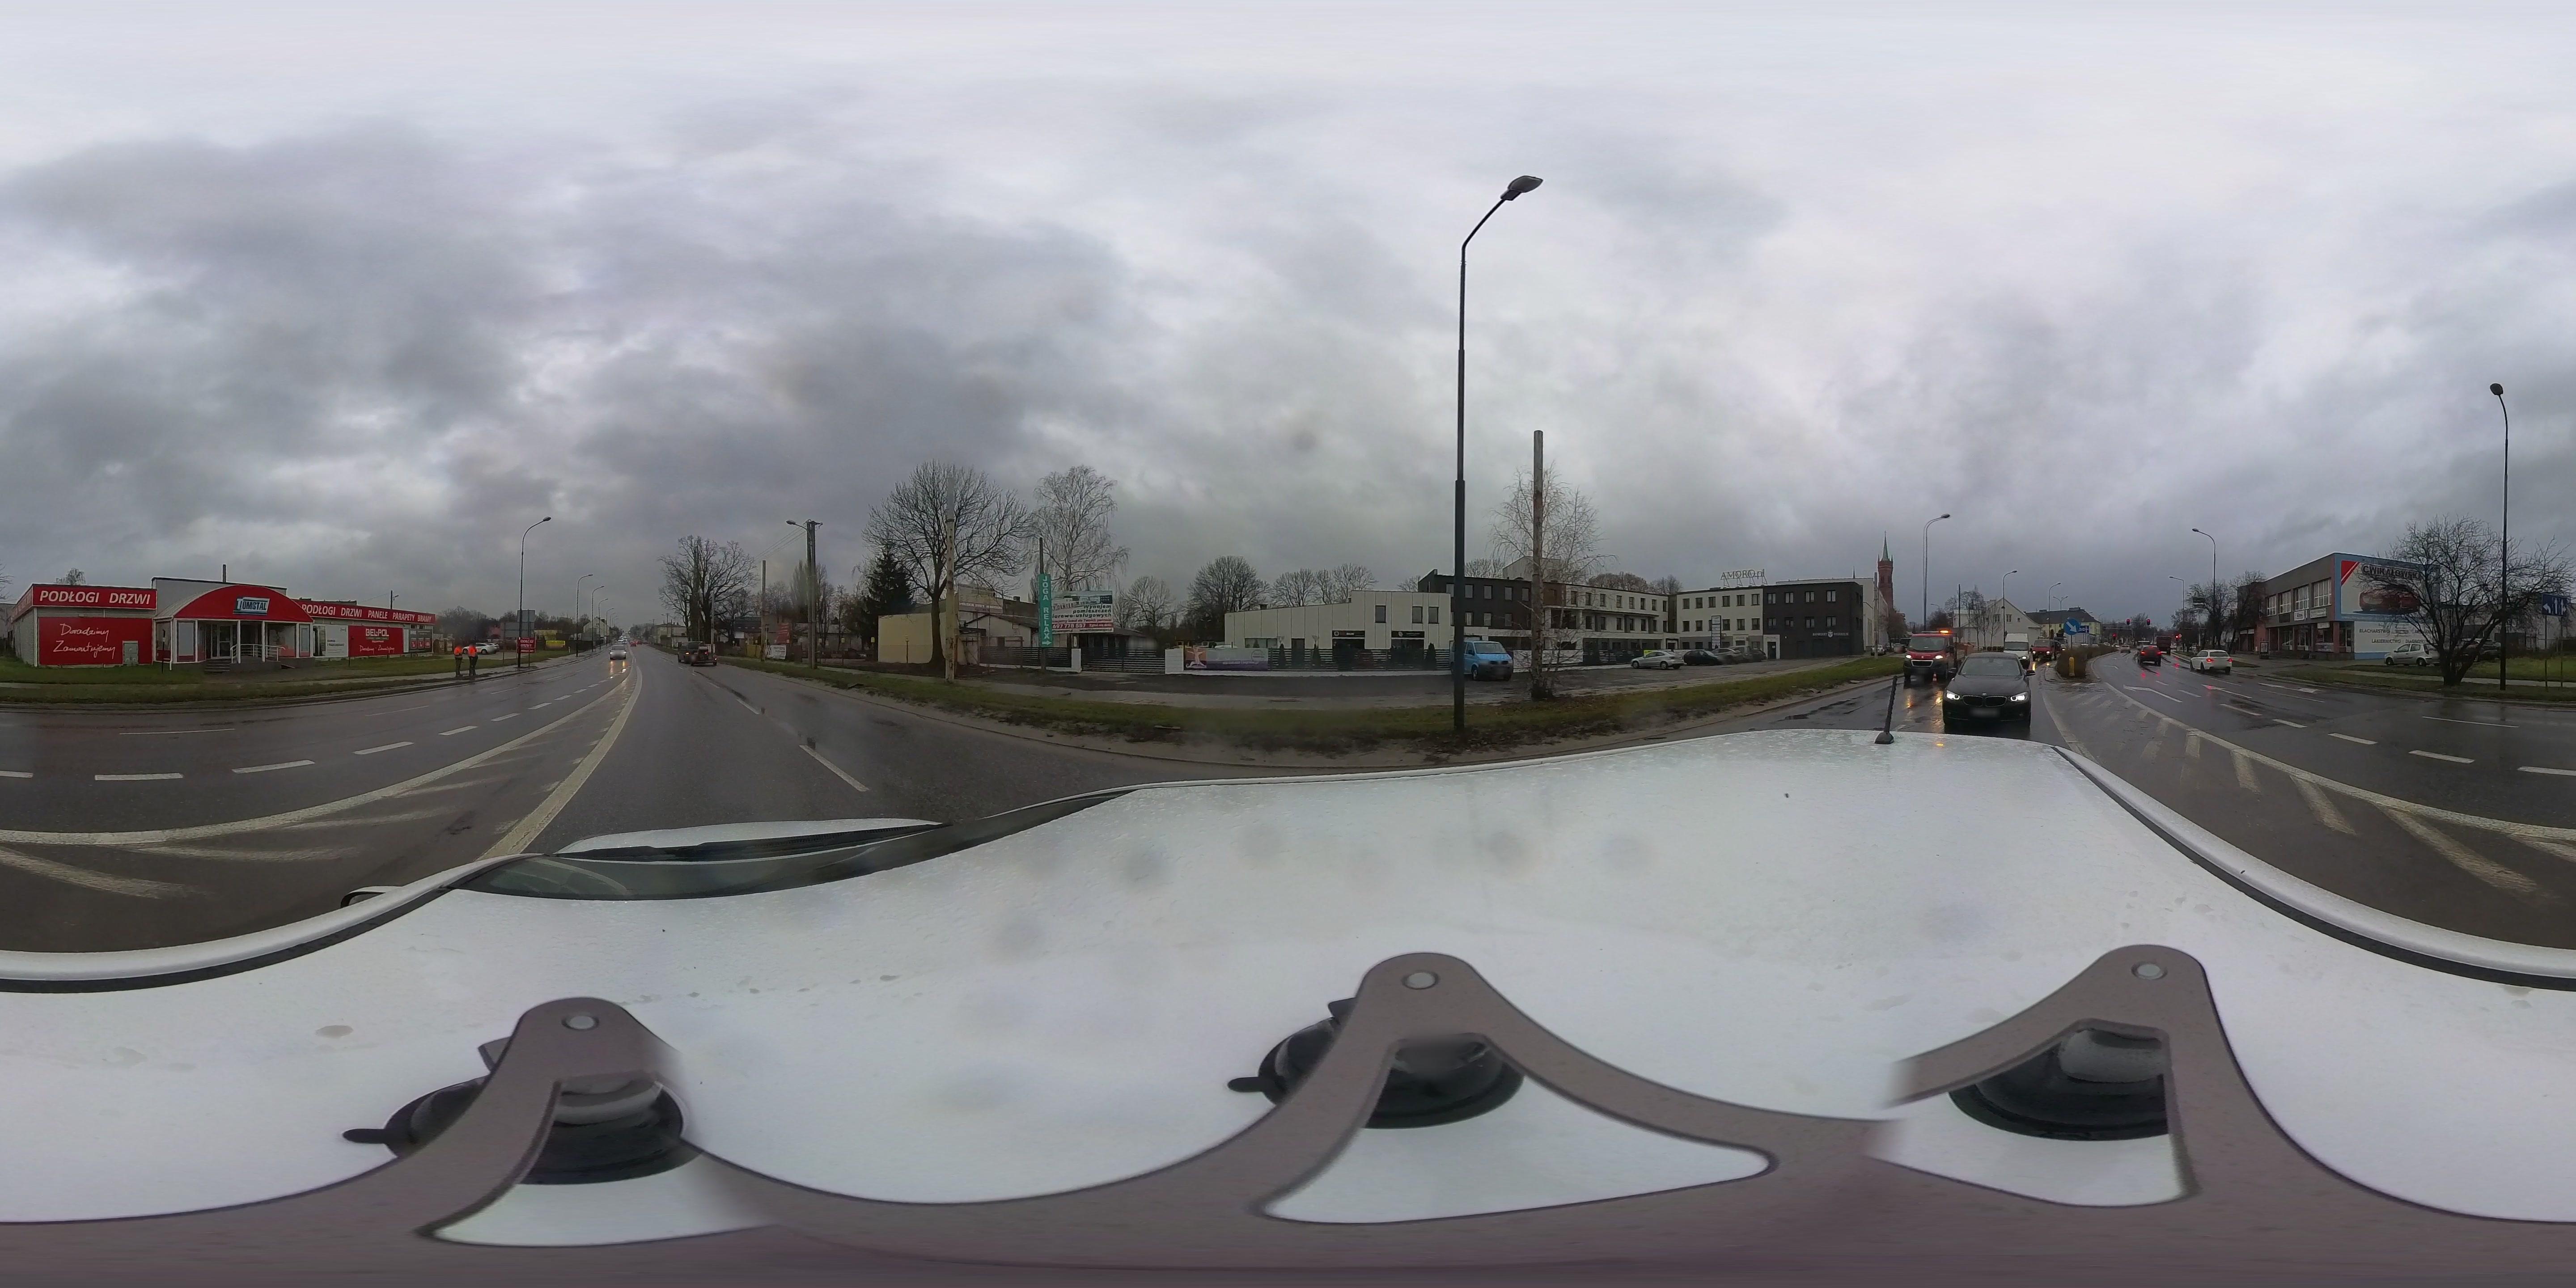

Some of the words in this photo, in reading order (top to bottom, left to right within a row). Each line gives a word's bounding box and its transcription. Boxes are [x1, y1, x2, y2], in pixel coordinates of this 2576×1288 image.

[1720, 568, 1765, 580] AMORO.pl
[39, 590, 99, 602] PODŁOGI
[109, 593, 151, 604] DRZWI
[237, 598, 267, 610] TOMSTAL
[301, 604, 336, 615] PODŁOGI
[341, 607, 362, 618] DRZWI
[368, 610, 388, 619] PANELE
[393, 612, 415, 621] PARAPETY
[60, 623, 109, 643] Doradzimy
[53, 640, 115, 659] Zamontujemy
